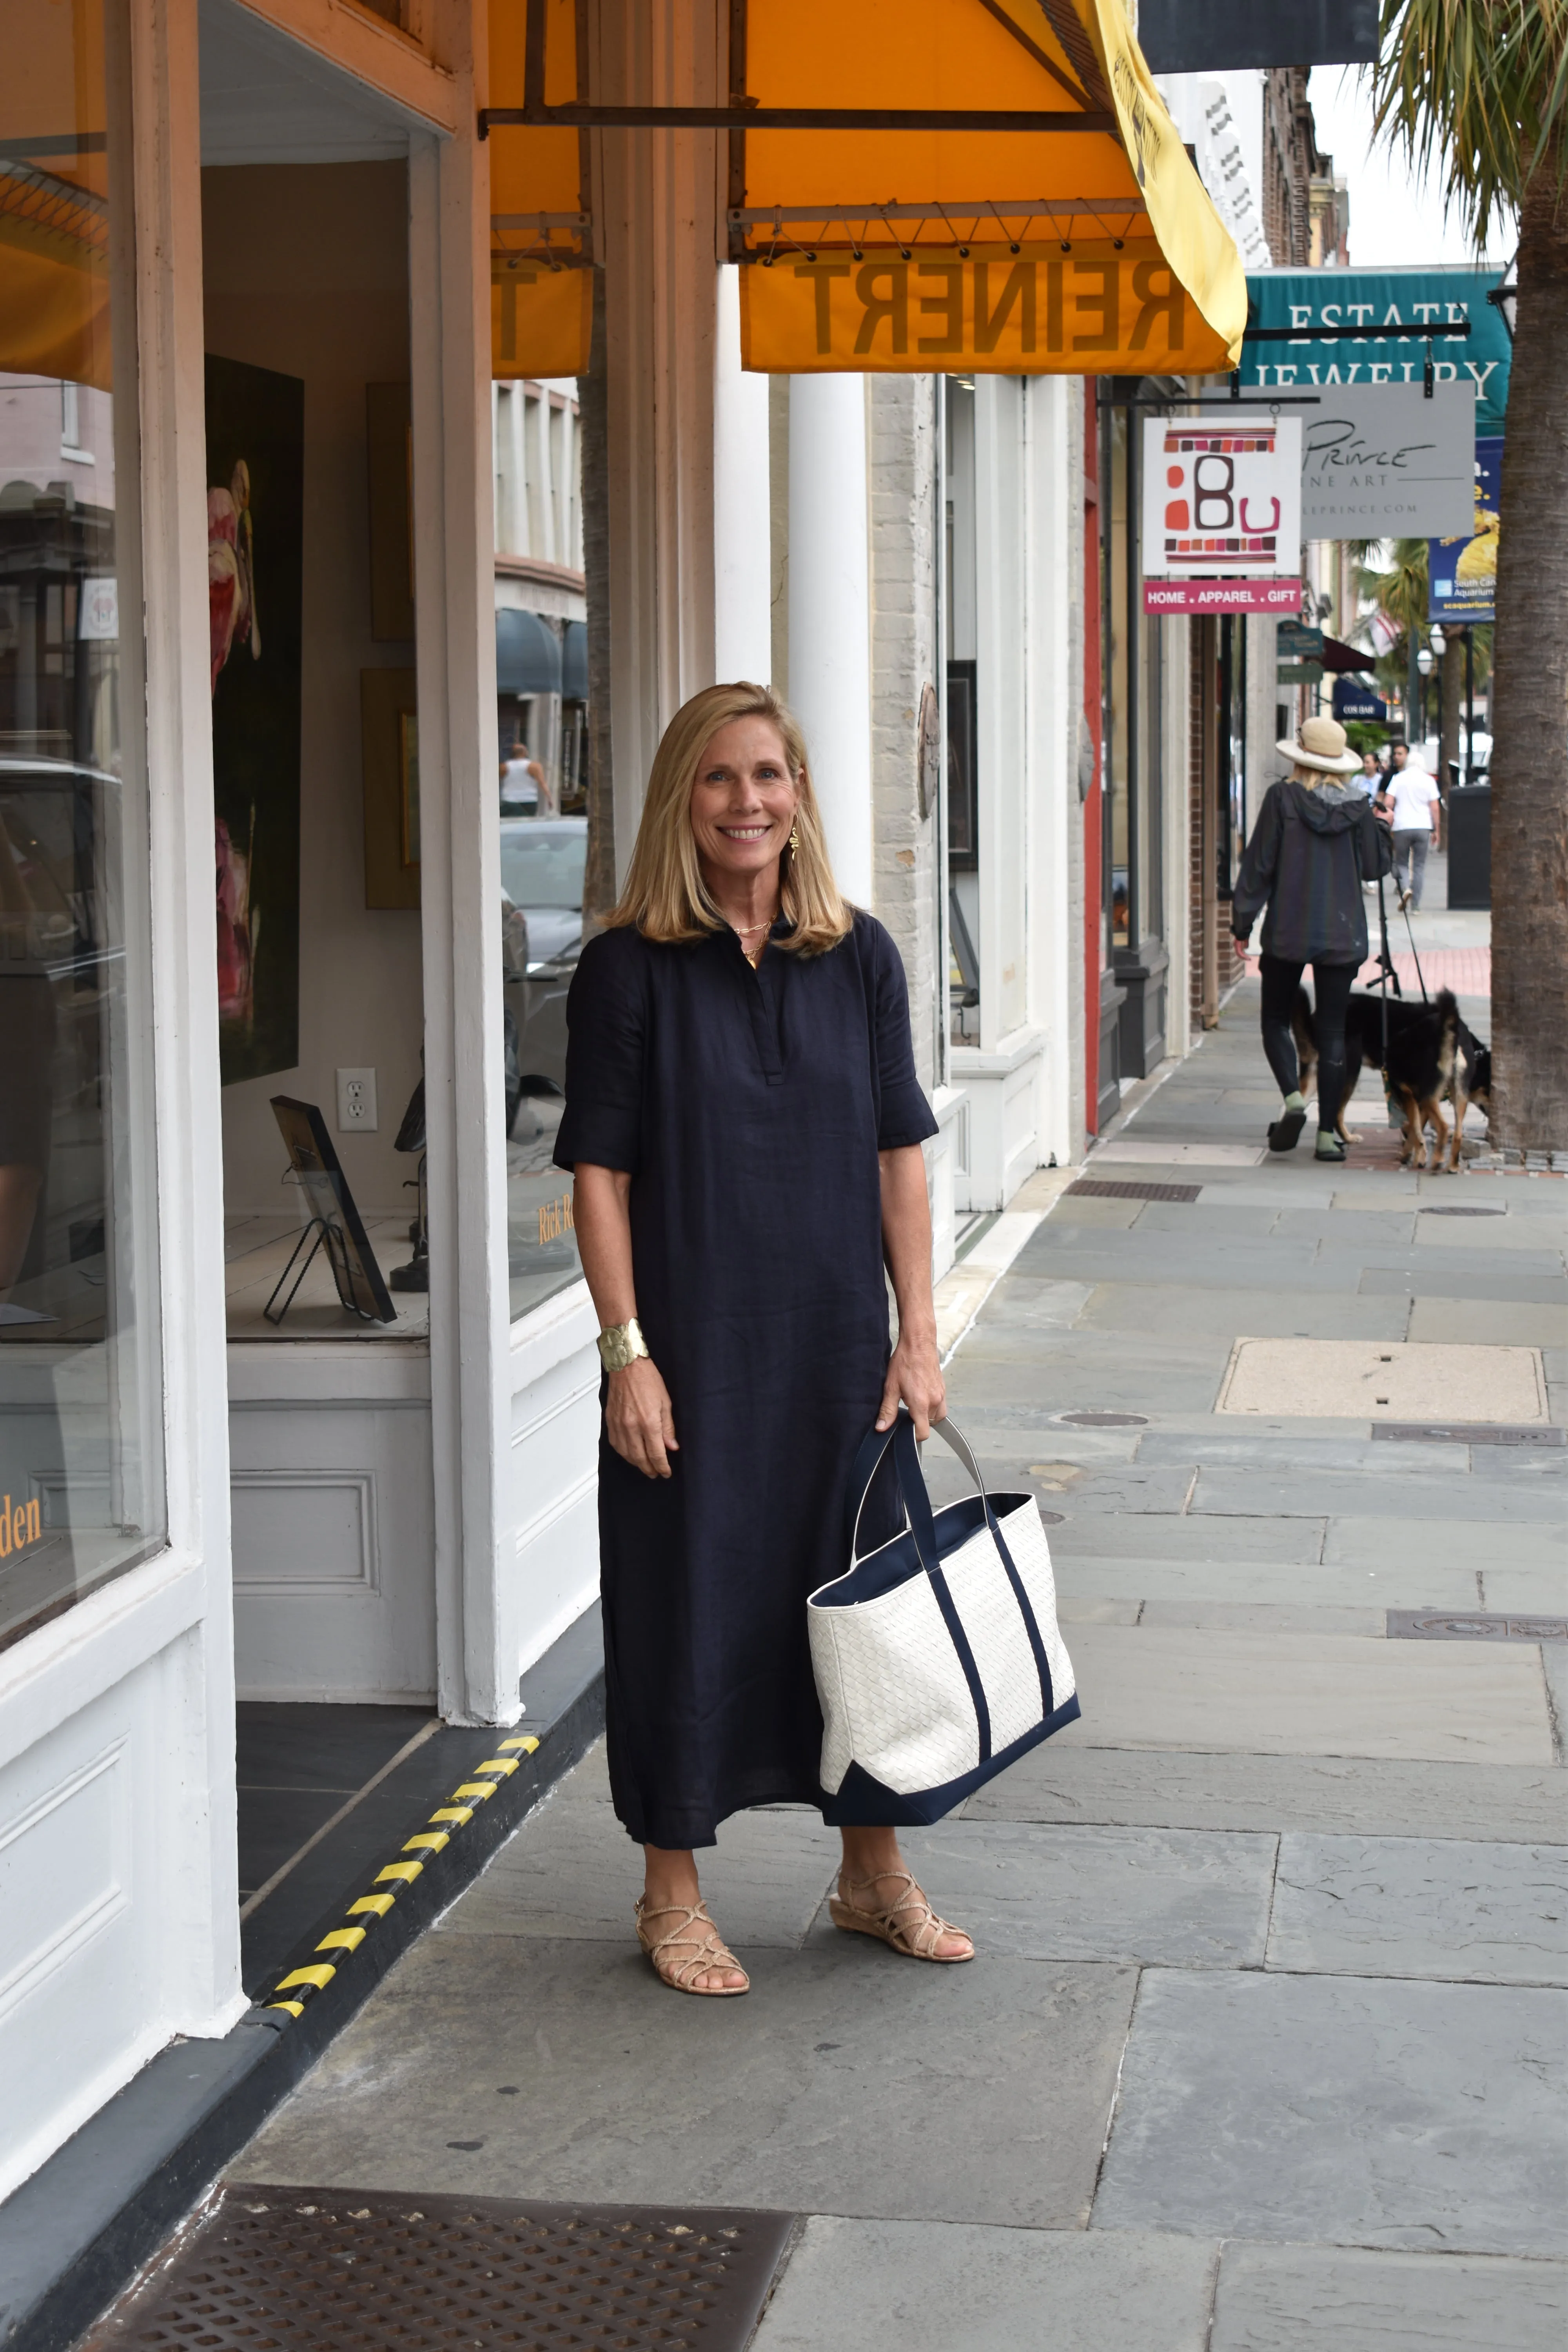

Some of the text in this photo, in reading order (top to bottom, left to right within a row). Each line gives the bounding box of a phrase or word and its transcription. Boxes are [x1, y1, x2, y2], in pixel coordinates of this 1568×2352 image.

[1288, 303, 1468, 345] ESTATE
[1350, 474, 1387, 487] ART
[1454, 579, 1478, 588] South
[1147, 590, 1296, 604] HOME APPAREL GIFT
[1454, 589, 1495, 598] Aquarium
[1359, 704, 1375, 715] BAR
[539, 1200, 561, 1245] Rick
